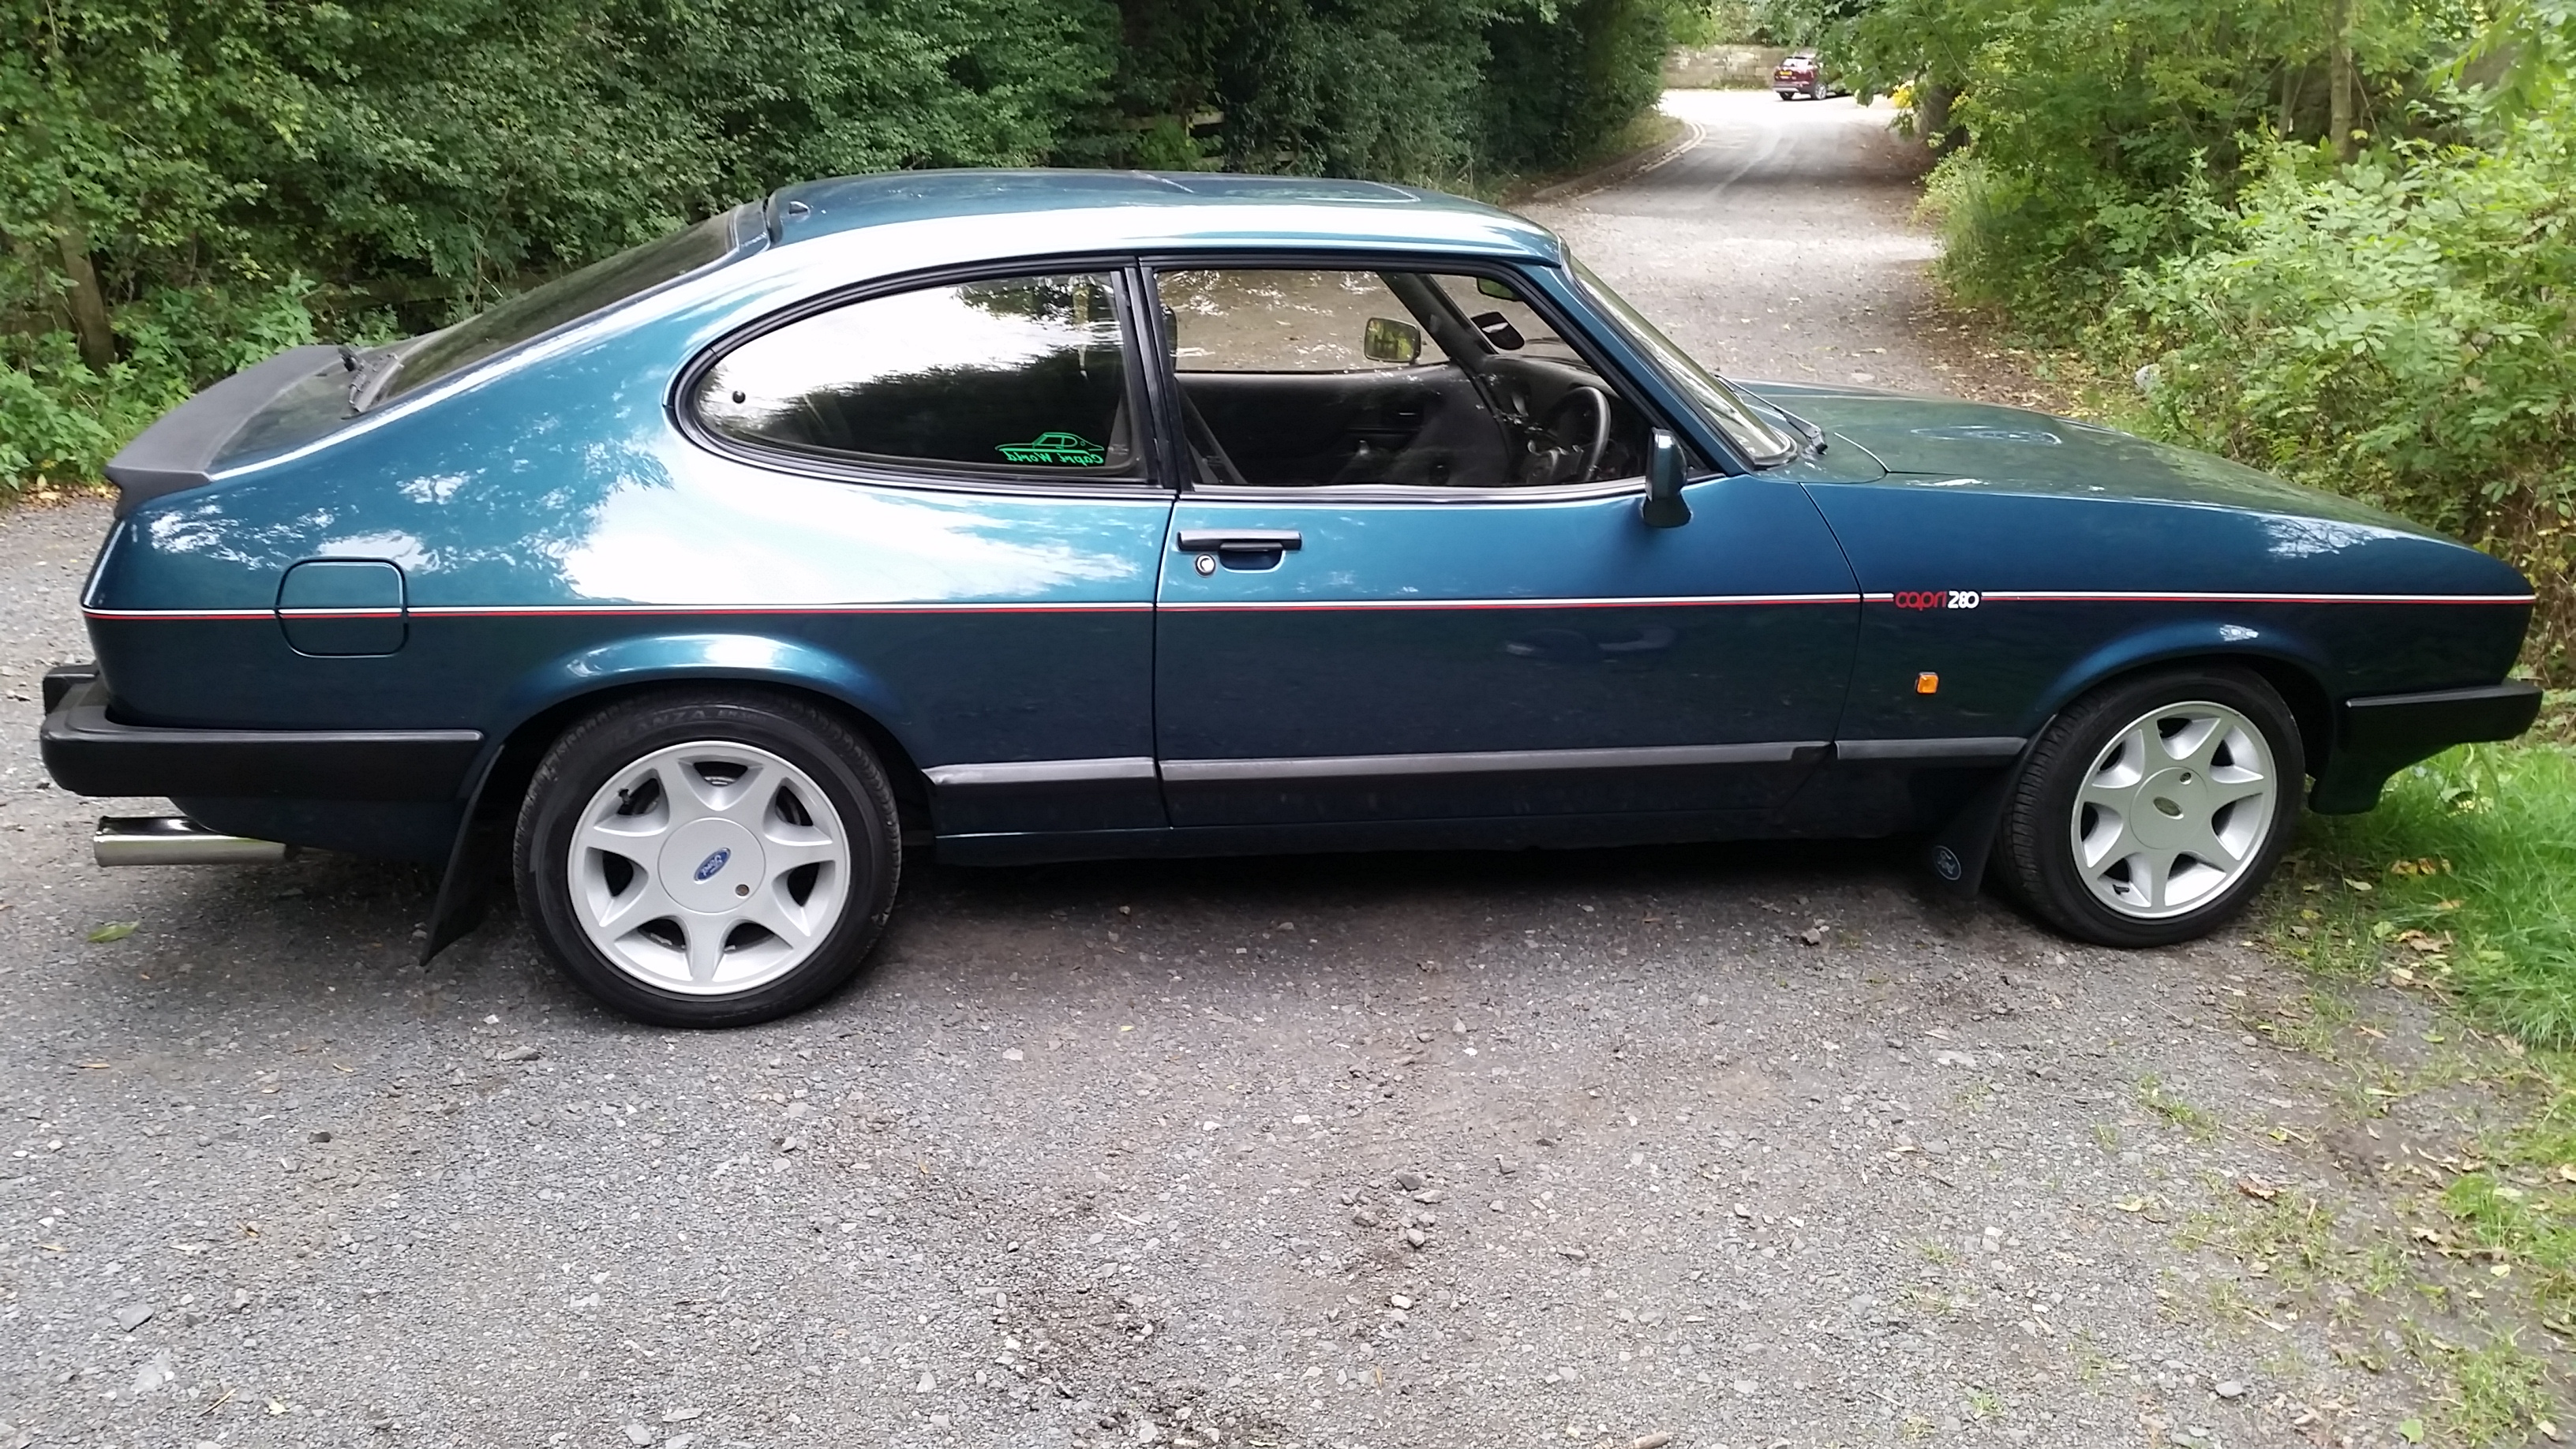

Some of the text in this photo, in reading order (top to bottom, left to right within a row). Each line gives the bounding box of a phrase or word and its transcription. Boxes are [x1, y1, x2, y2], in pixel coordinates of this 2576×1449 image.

[1896, 590, 1979, 611] capri 280
[700, 854, 723, 876] Ford
